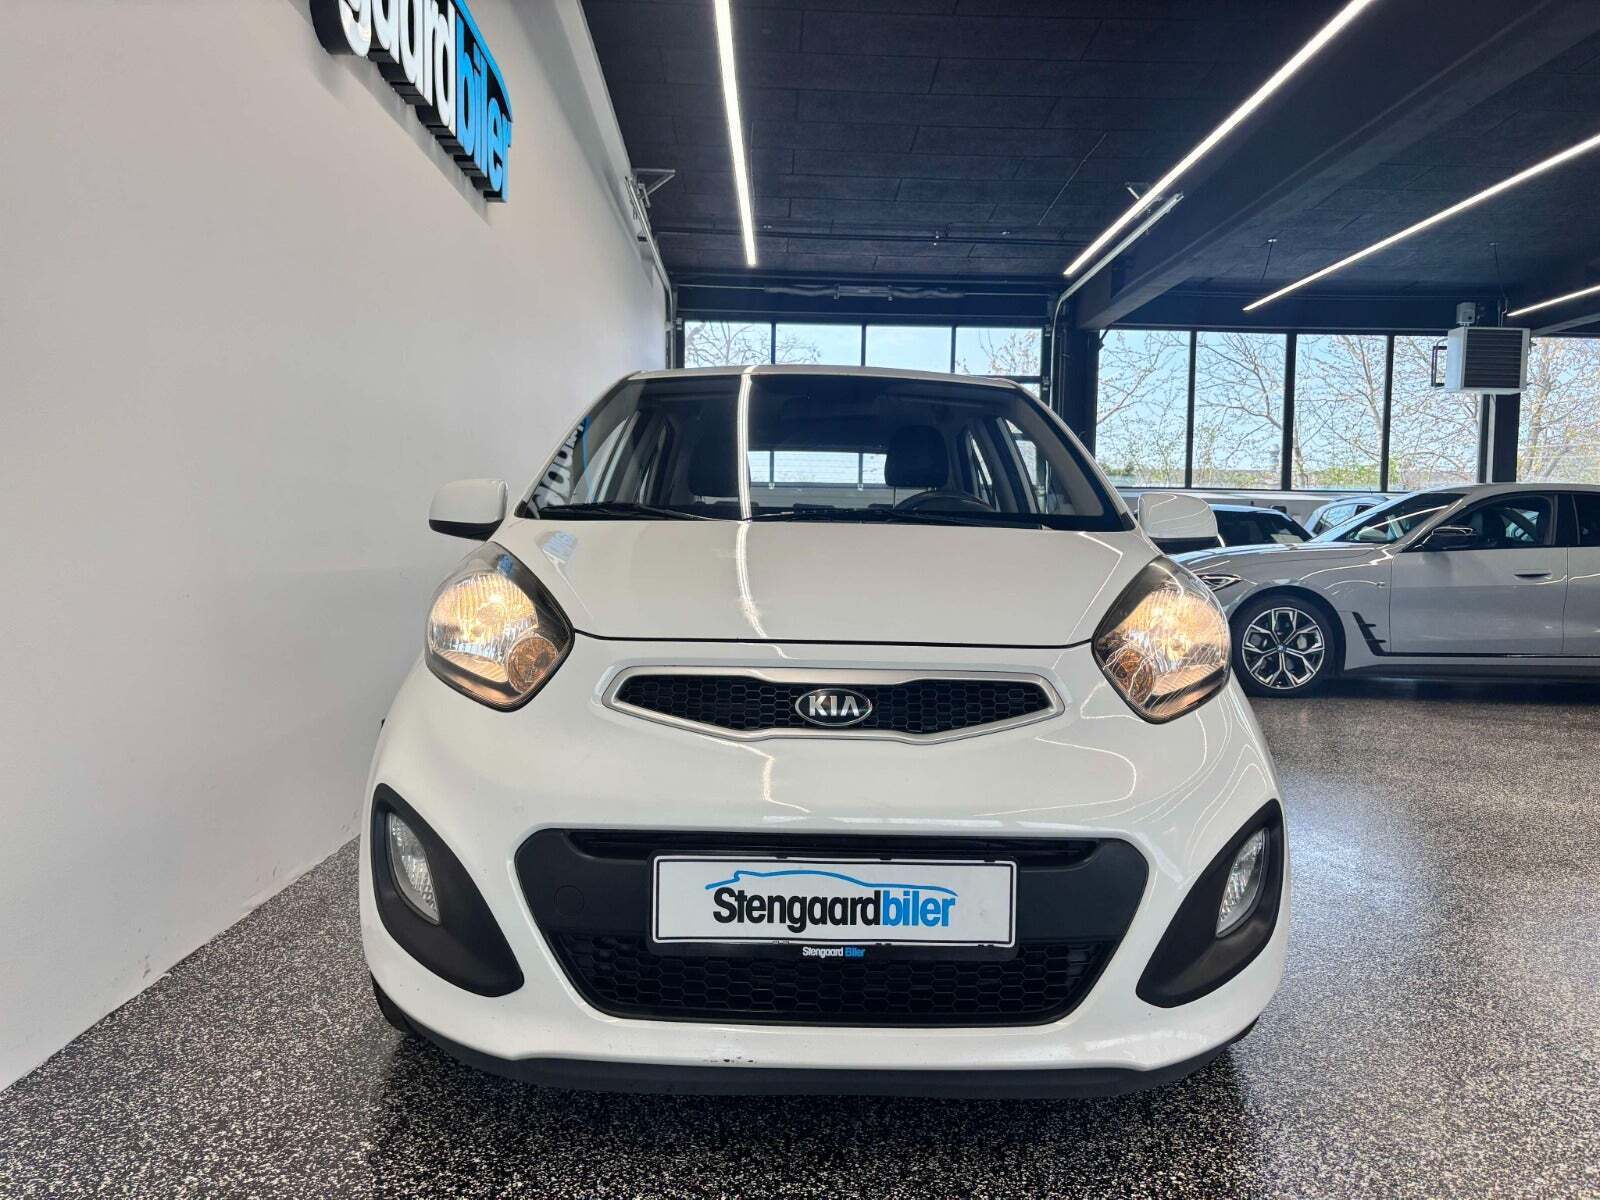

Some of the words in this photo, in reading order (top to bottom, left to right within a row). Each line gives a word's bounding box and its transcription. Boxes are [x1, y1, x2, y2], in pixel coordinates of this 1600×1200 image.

[809, 695, 860, 717] KIA
[713, 887, 956, 933] Stengaardbiler
[803, 946, 843, 959] Stengaard
